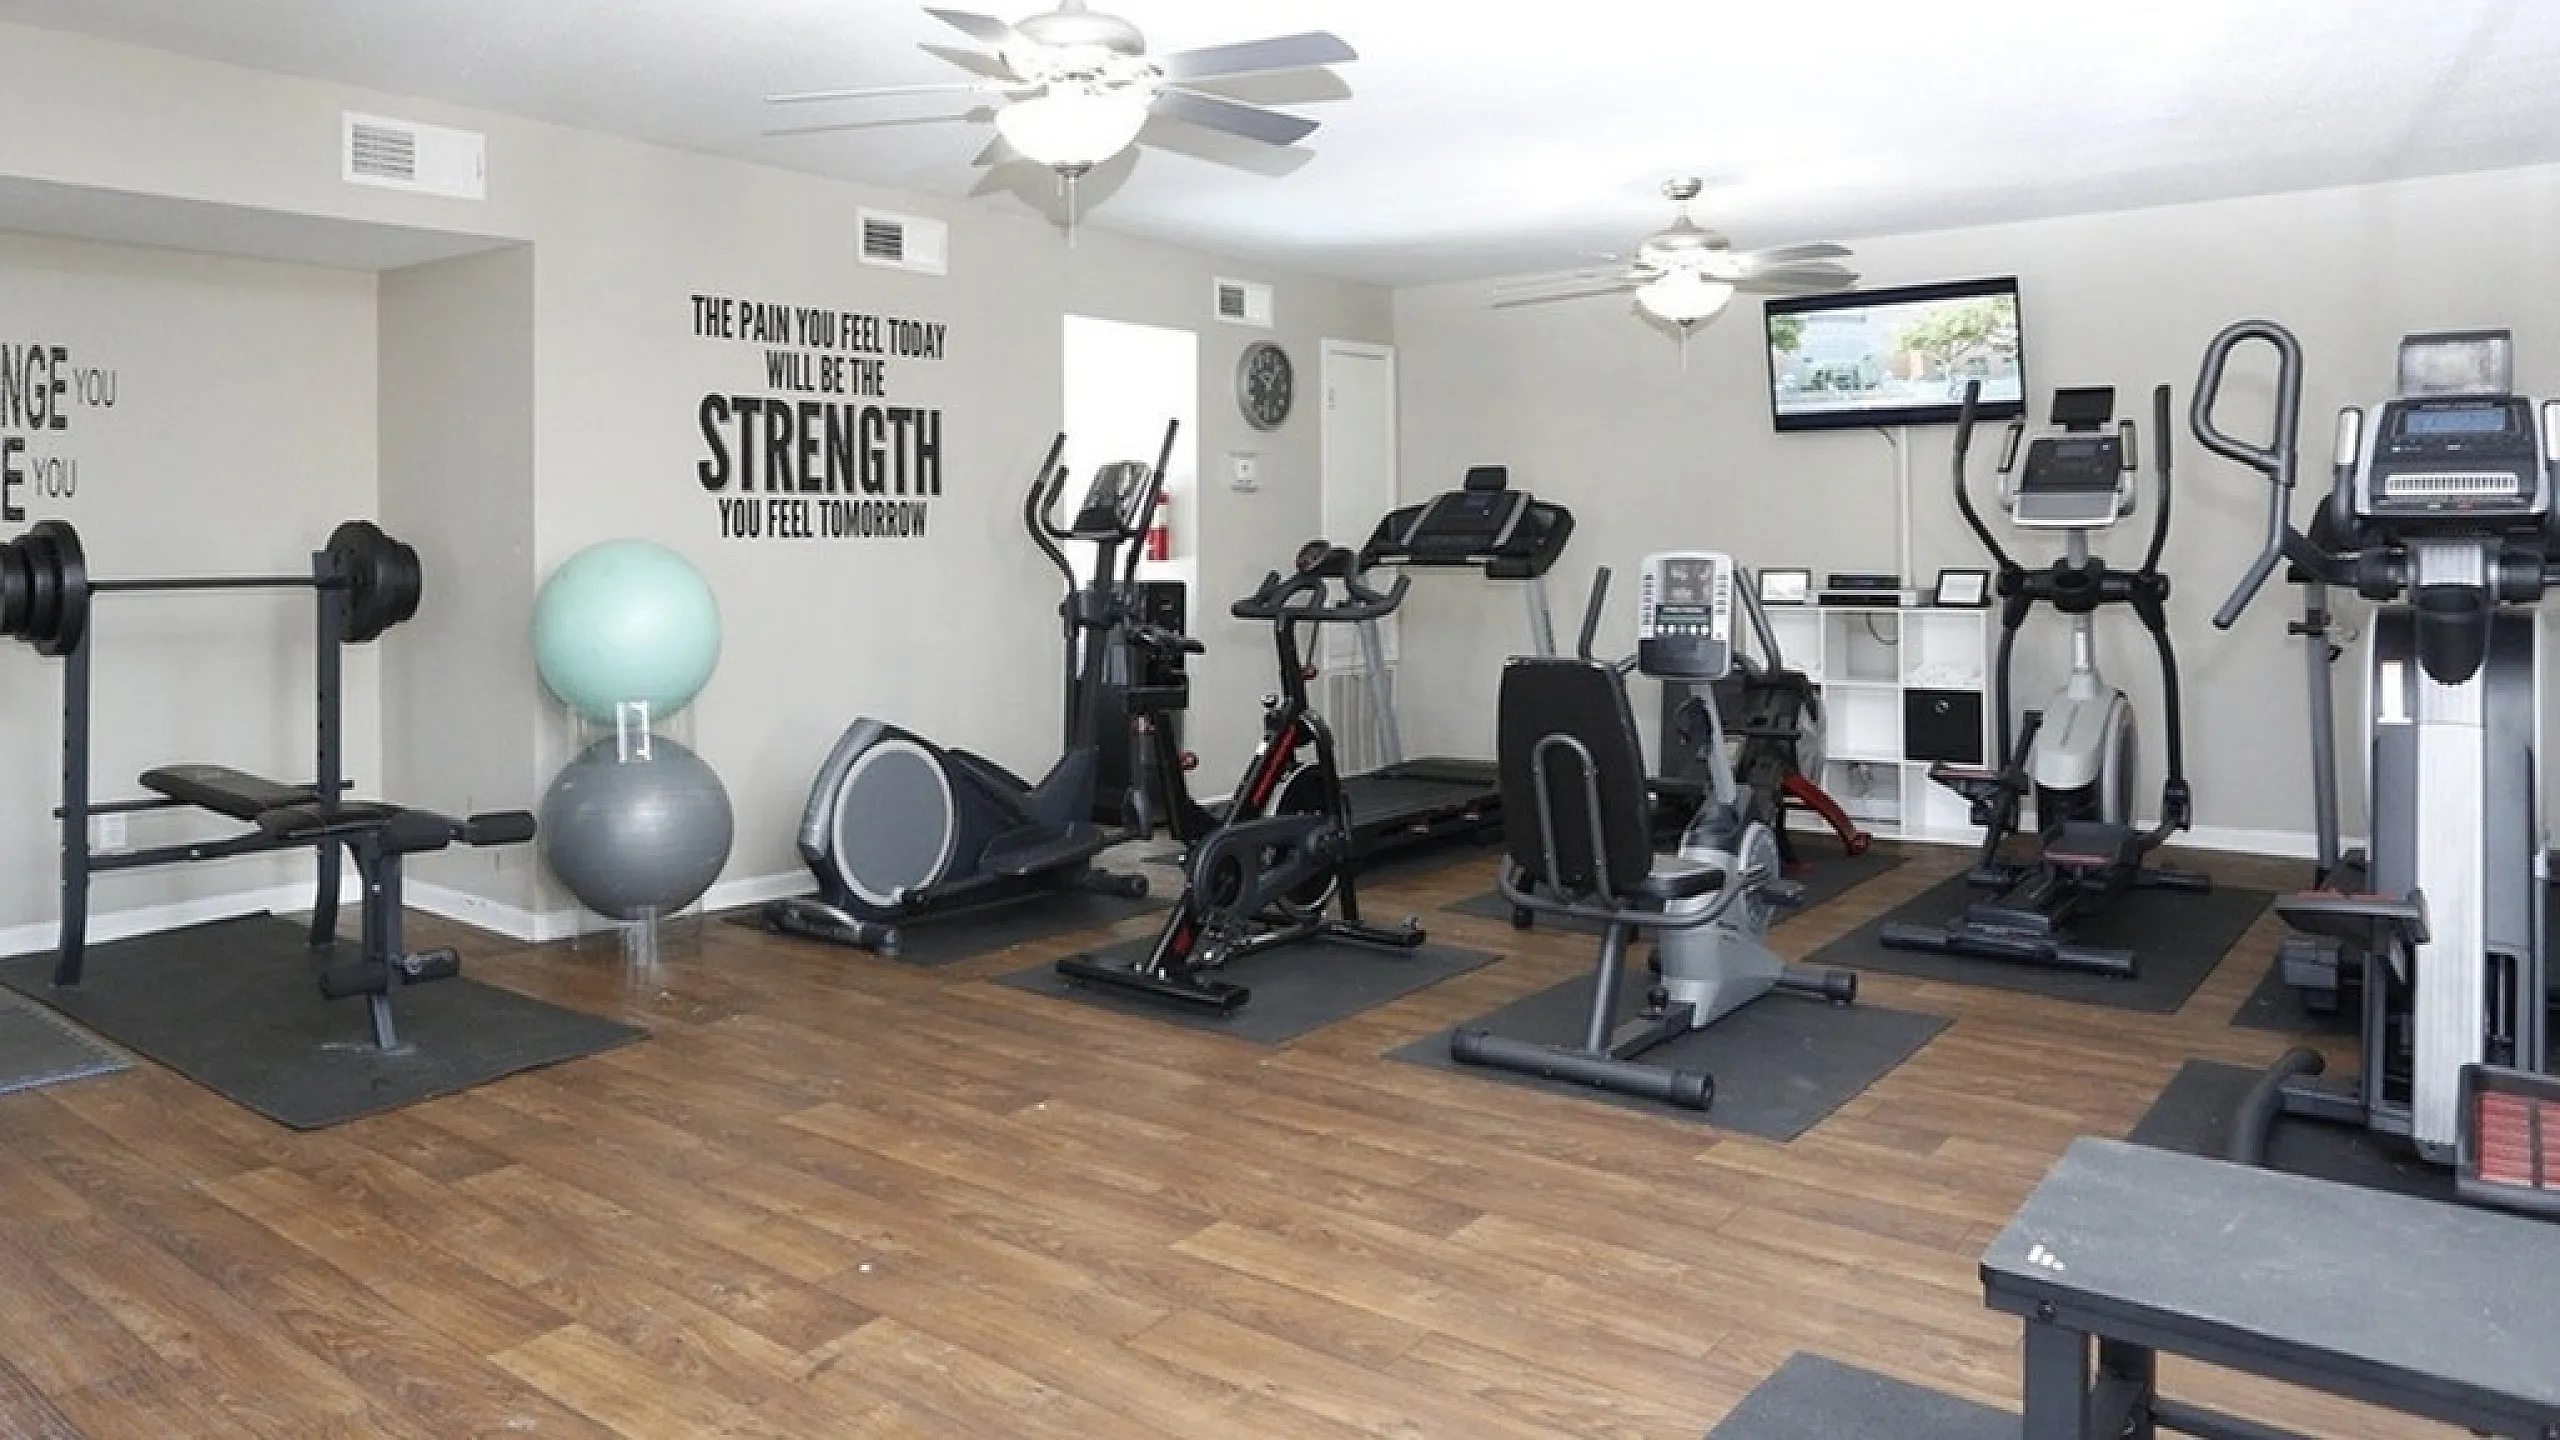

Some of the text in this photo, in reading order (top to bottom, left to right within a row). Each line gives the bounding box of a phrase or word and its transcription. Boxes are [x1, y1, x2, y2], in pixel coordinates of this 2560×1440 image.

[691, 294, 947, 360] THE PAIN YOU FEEL TODAY
[73, 368, 118, 408] YOU
[765, 350, 885, 398] WILL BE THE
[697, 393, 942, 496] STRENGTH
[32, 457, 77, 498] YOU
[718, 498, 928, 538] YOU FEEL TOMORROW
